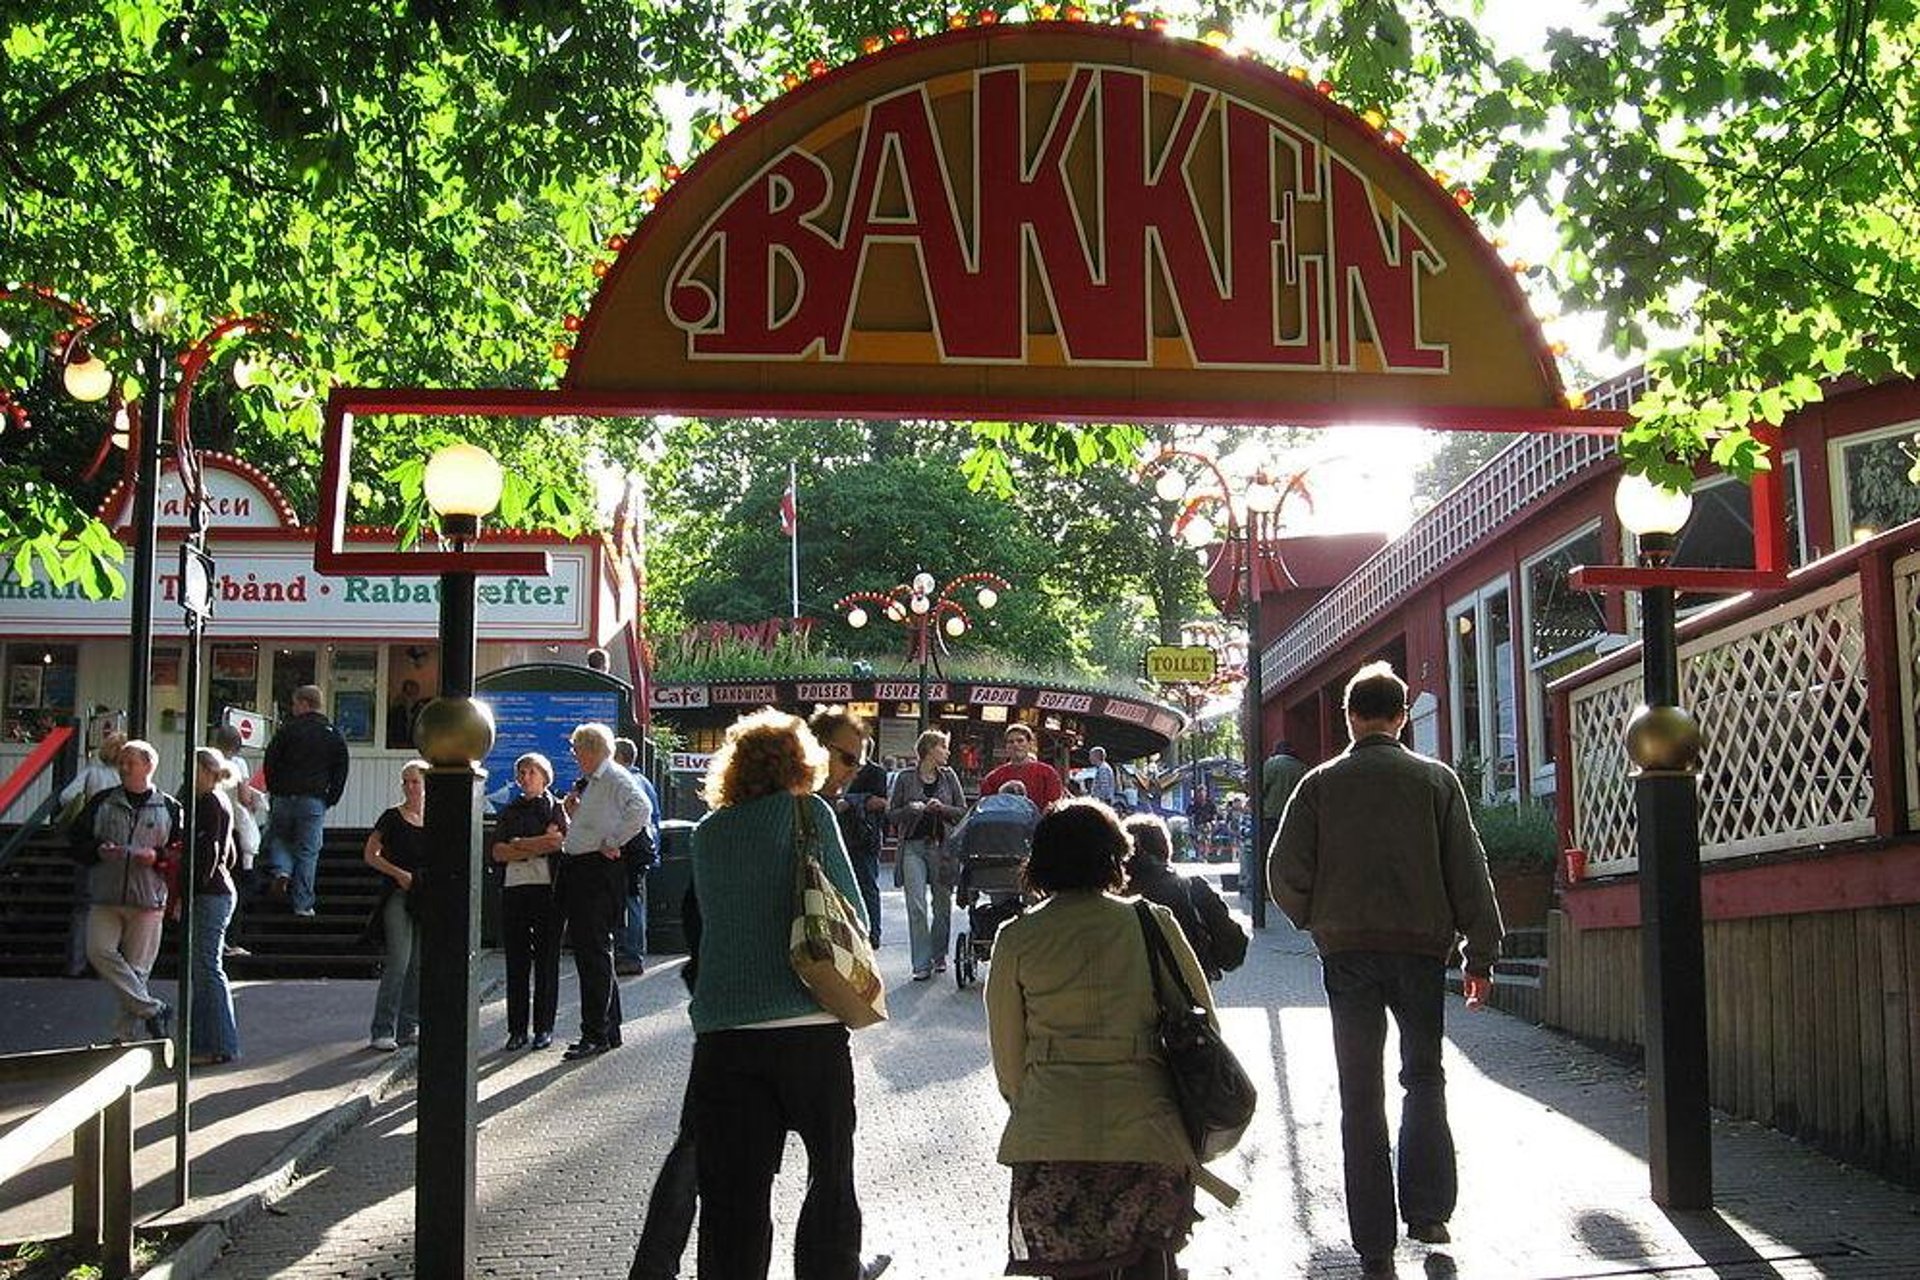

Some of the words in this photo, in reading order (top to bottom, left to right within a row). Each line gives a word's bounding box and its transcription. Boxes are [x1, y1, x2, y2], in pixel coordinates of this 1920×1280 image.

[664, 63, 1450, 374] BAKKEN
[1153, 656, 1212, 673] TOILET
[715, 687, 774, 701] SANDWICH
